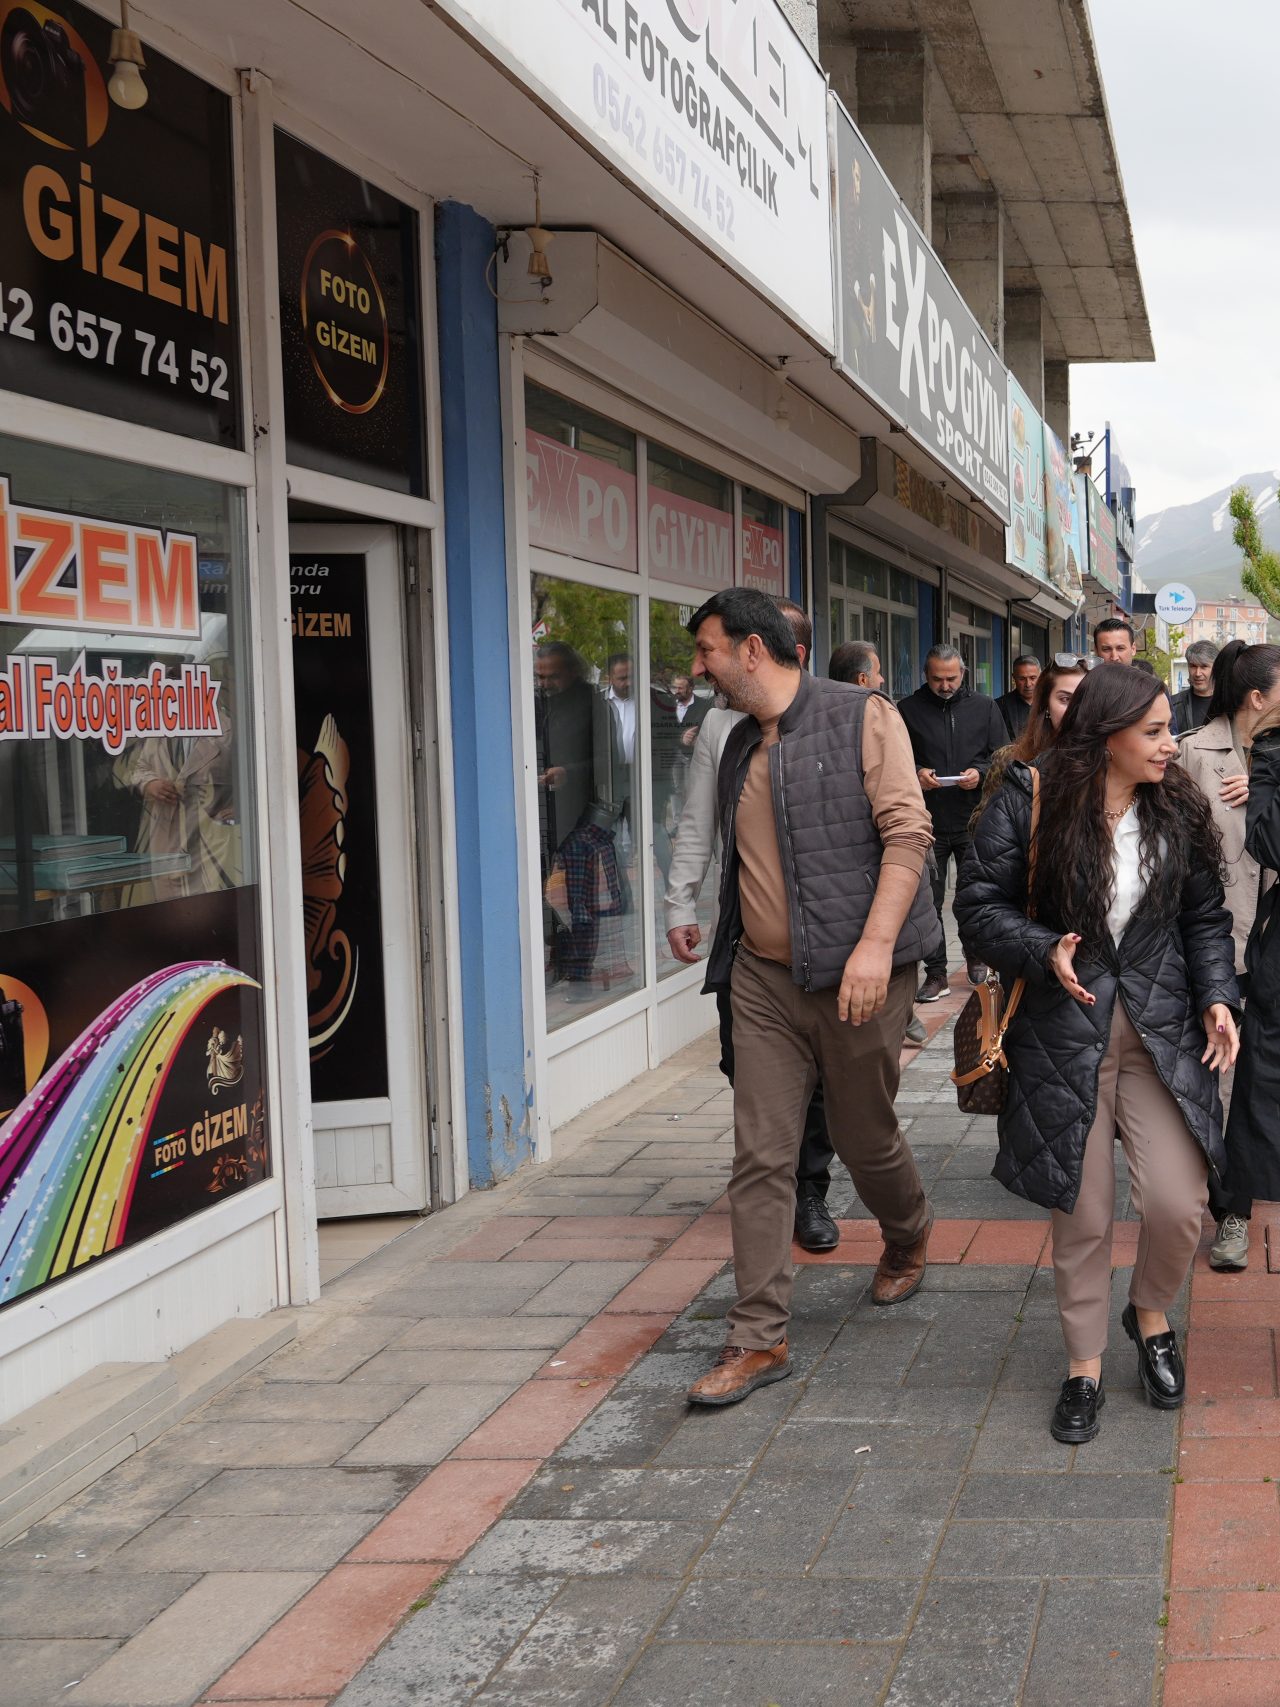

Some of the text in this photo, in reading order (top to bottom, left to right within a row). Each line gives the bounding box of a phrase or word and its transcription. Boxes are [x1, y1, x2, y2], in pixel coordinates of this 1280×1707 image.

[625, 0, 779, 217] FOTOĞRAFÇILIK
[593, 62, 735, 242] 0542 657 74 52
[22, 161, 229, 325] GİZEM
[320, 268, 370, 314] FOTO
[882, 208, 957, 422] EXPO
[50, 302, 122, 365] 657
[135, 329, 180, 385] 74
[190, 348, 230, 400] 52
[316, 320, 377, 366] GİZEM
[936, 410, 983, 485] SPORT
[742, 525, 780, 569] EXPO
[33, 663, 218, 749] Fotoğrafcılık
[154, 1103, 249, 1167] FOTO GİZEM
